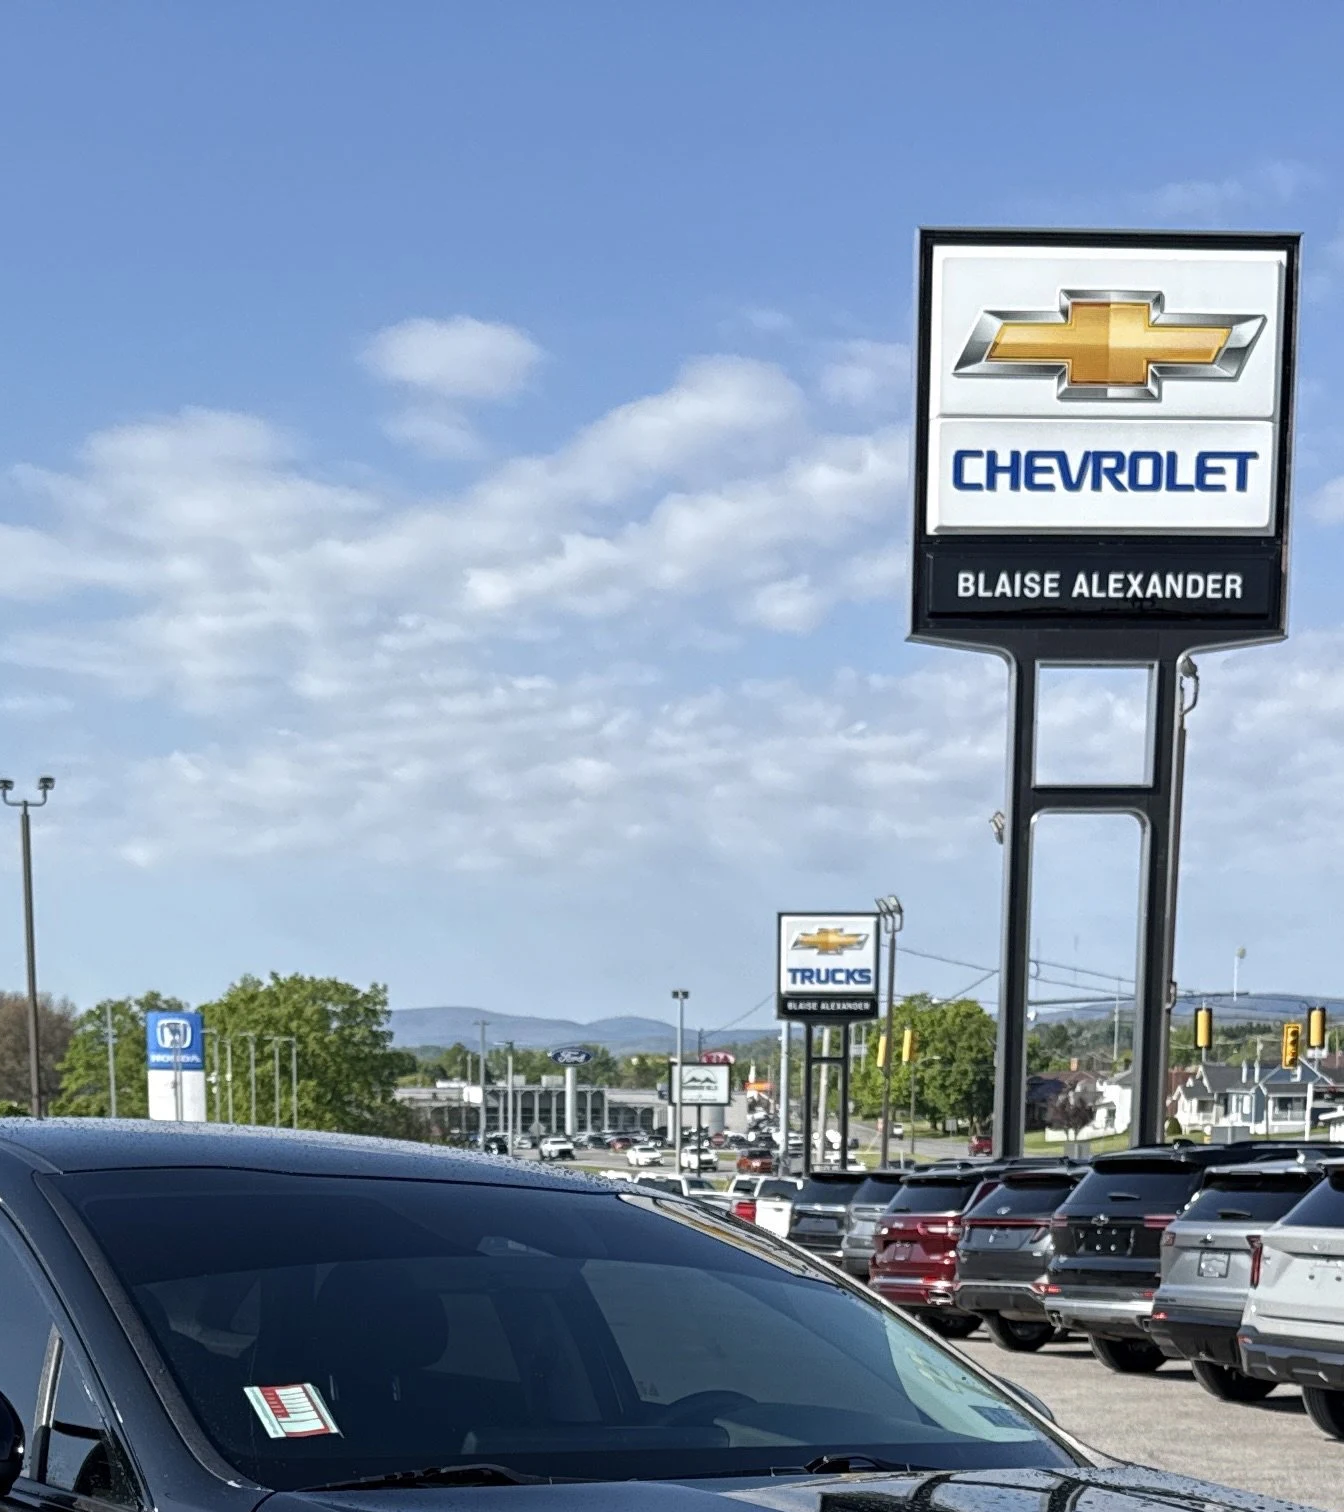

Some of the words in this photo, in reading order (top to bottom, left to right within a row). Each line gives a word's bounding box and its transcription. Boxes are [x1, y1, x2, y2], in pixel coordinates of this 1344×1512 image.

[952, 449, 1259, 493] CHEVROLET
[956, 571, 1061, 599] BLAISE
[1071, 571, 1244, 600] ALEXANDER
[787, 968, 872, 985] TRUCKS
[787, 1001, 817, 1011] BLAISE
[820, 1001, 871, 1011] ALEXANDER
[557, 1050, 587, 1063] Ford
